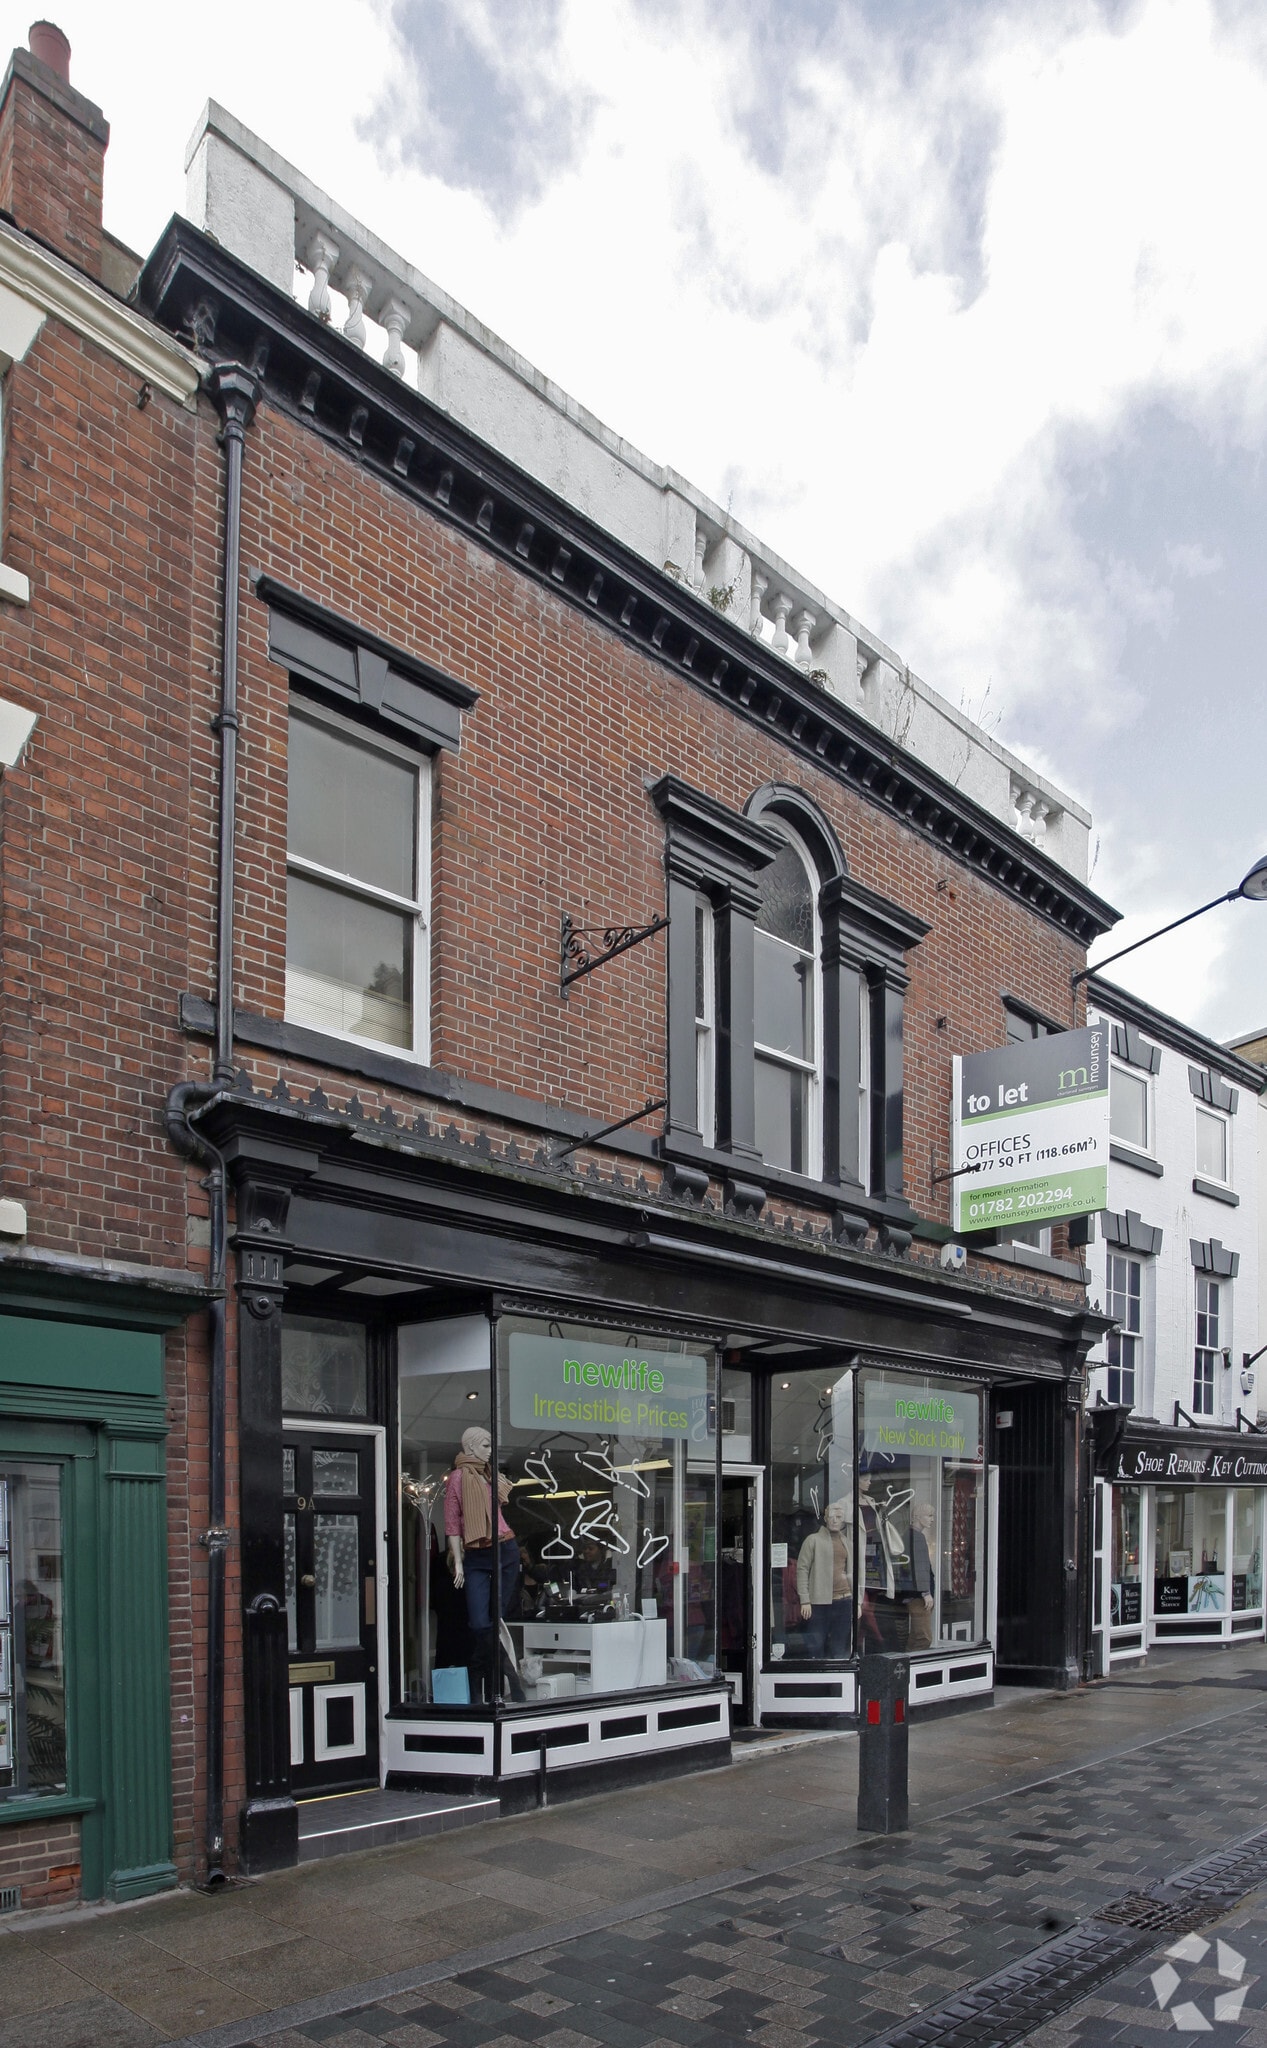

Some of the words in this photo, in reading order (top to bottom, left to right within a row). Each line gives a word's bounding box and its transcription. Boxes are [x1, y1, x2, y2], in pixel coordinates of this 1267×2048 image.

[1090, 1031, 1103, 1083] mounsey
[967, 1093, 991, 1113] to
[998, 1082, 1029, 1107] let
[966, 1133, 1031, 1159] OFFICES
[999, 1156, 1014, 1168] SQ
[1018, 1152, 1032, 1164] FT
[969, 1193, 982, 1202] for
[982, 1189, 1002, 1200] more
[1003, 1180, 1049, 1196] information
[969, 1198, 1013, 1217] 01782
[1018, 1186, 1073, 1208] 202294
[968, 1196, 1097, 1225] www.mounseysurveyors.co.uk
[563, 1358, 665, 1393] newlife
[533, 1393, 632, 1425] Irresistible
[637, 1403, 689, 1429] Prices
[895, 1398, 955, 1424] newlife
[879, 1425, 906, 1445] New
[909, 1427, 937, 1448] Stock
[940, 1431, 966, 1454] Daily
[1135, 1450, 1164, 1474] SHOE
[1166, 1452, 1206, 1475] REPAIRS
[1211, 1455, 1233, 1477] KEY
[1163, 1586, 1179, 1594] KEY
